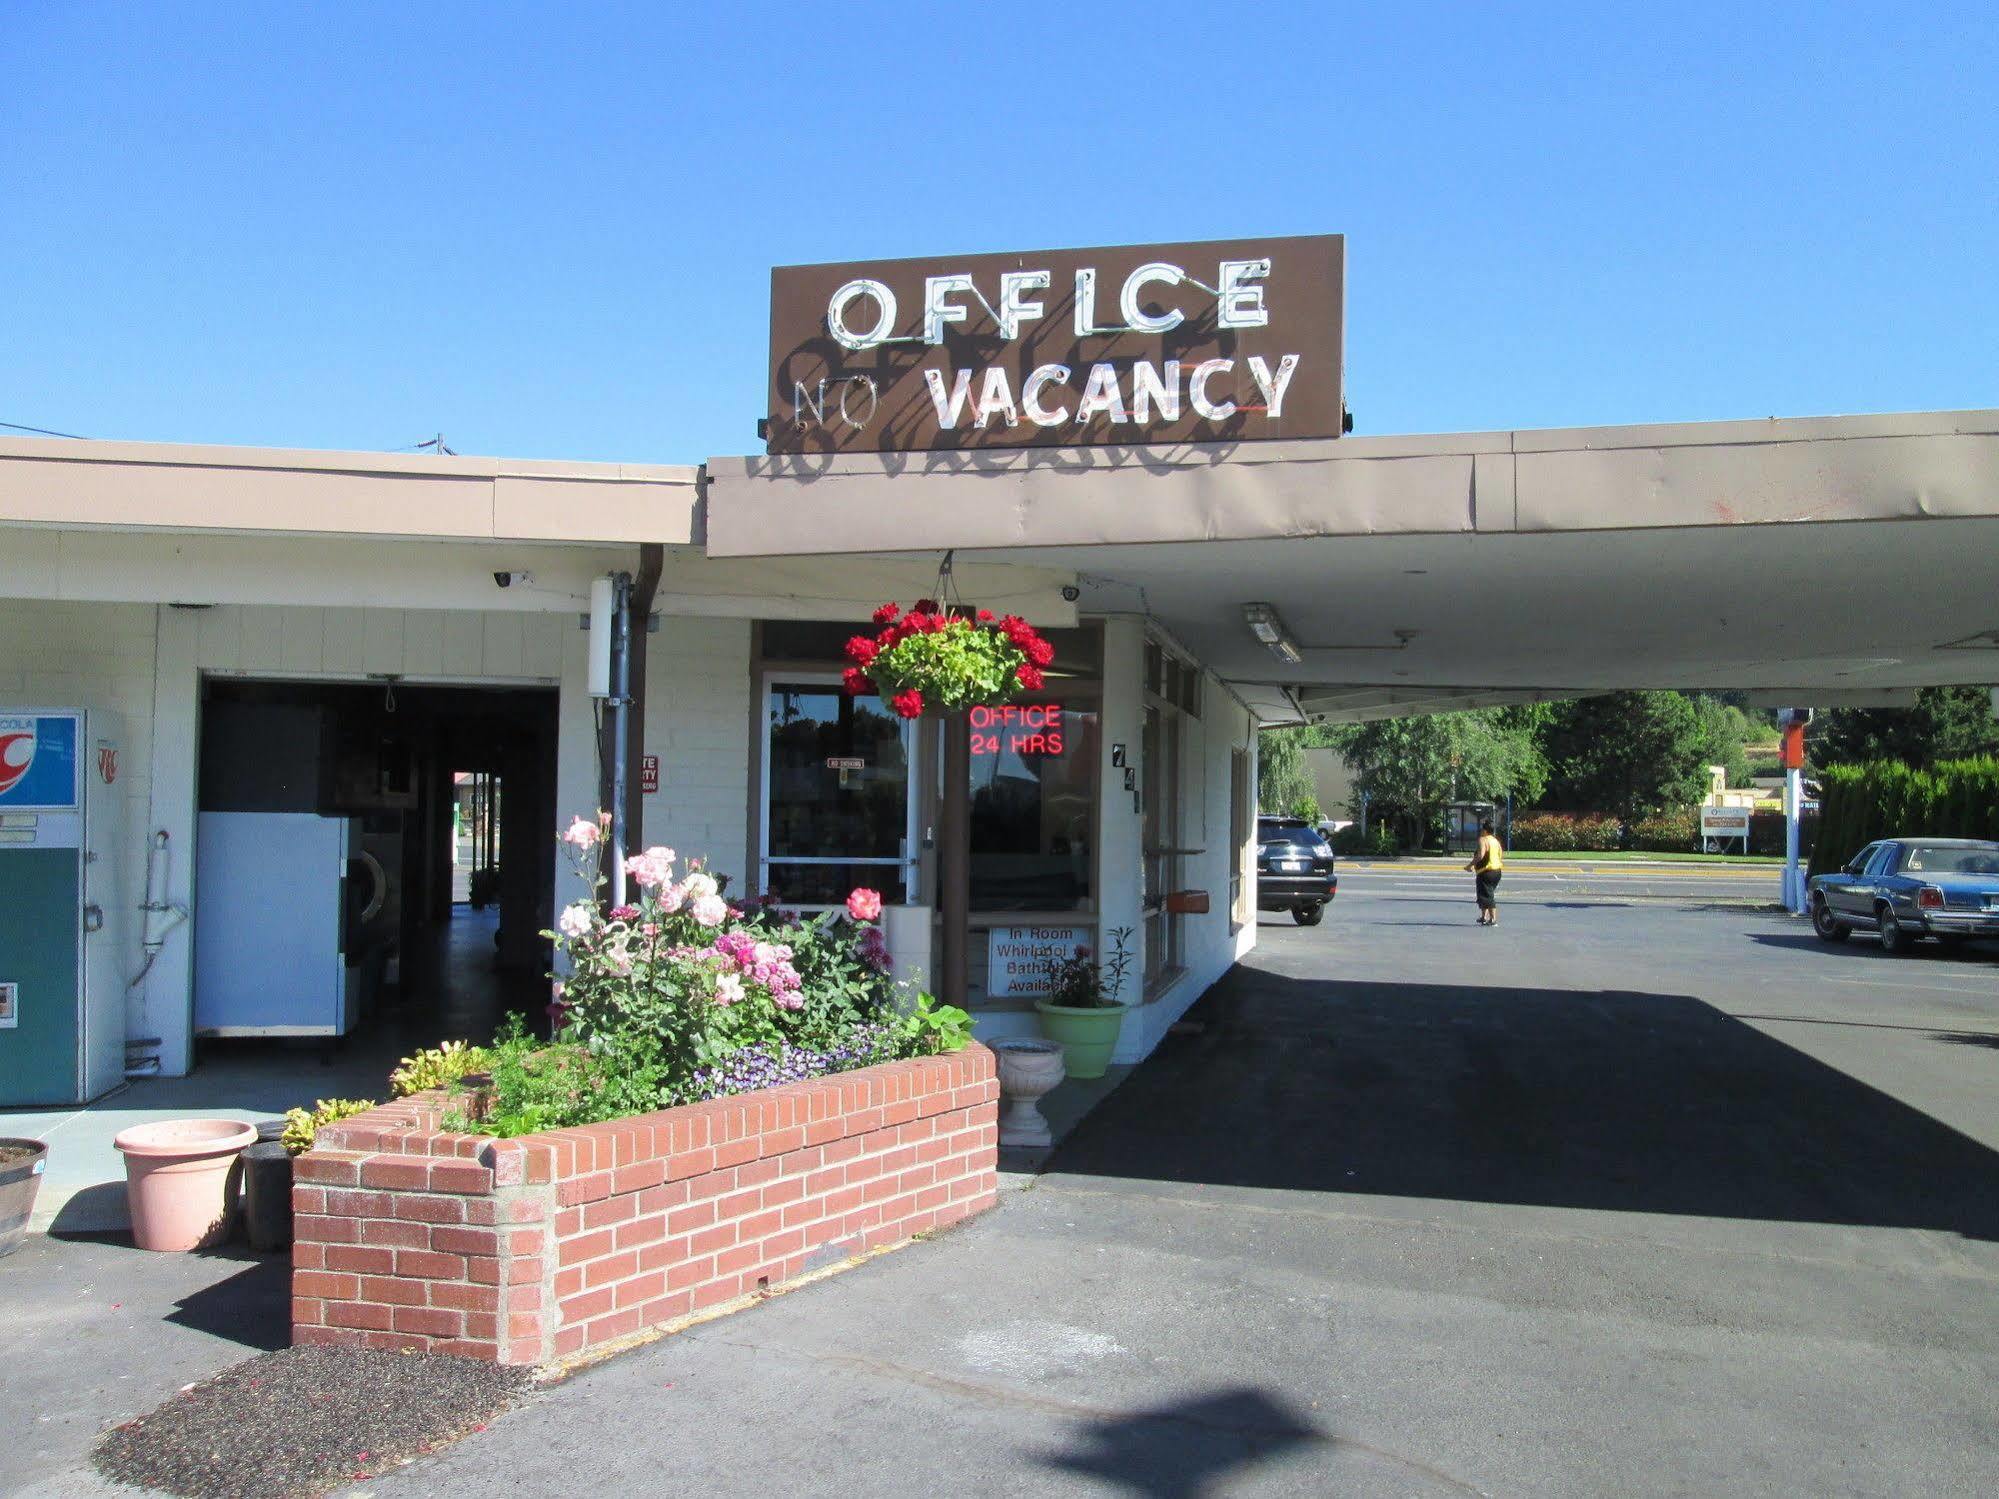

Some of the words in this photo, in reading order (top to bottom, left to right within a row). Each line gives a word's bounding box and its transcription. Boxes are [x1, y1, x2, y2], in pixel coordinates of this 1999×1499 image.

[828, 258, 1271, 350] OFFICE
[795, 374, 877, 430] NO
[925, 354, 1300, 430] VACANCY
[970, 705, 1060, 728] OFFICE
[971, 734, 999, 755] 24
[1011, 733, 1063, 755] HRS
[1009, 928, 1022, 939] In
[1031, 928, 1073, 939] Room
[997, 944, 1066, 959] Whirlpool
